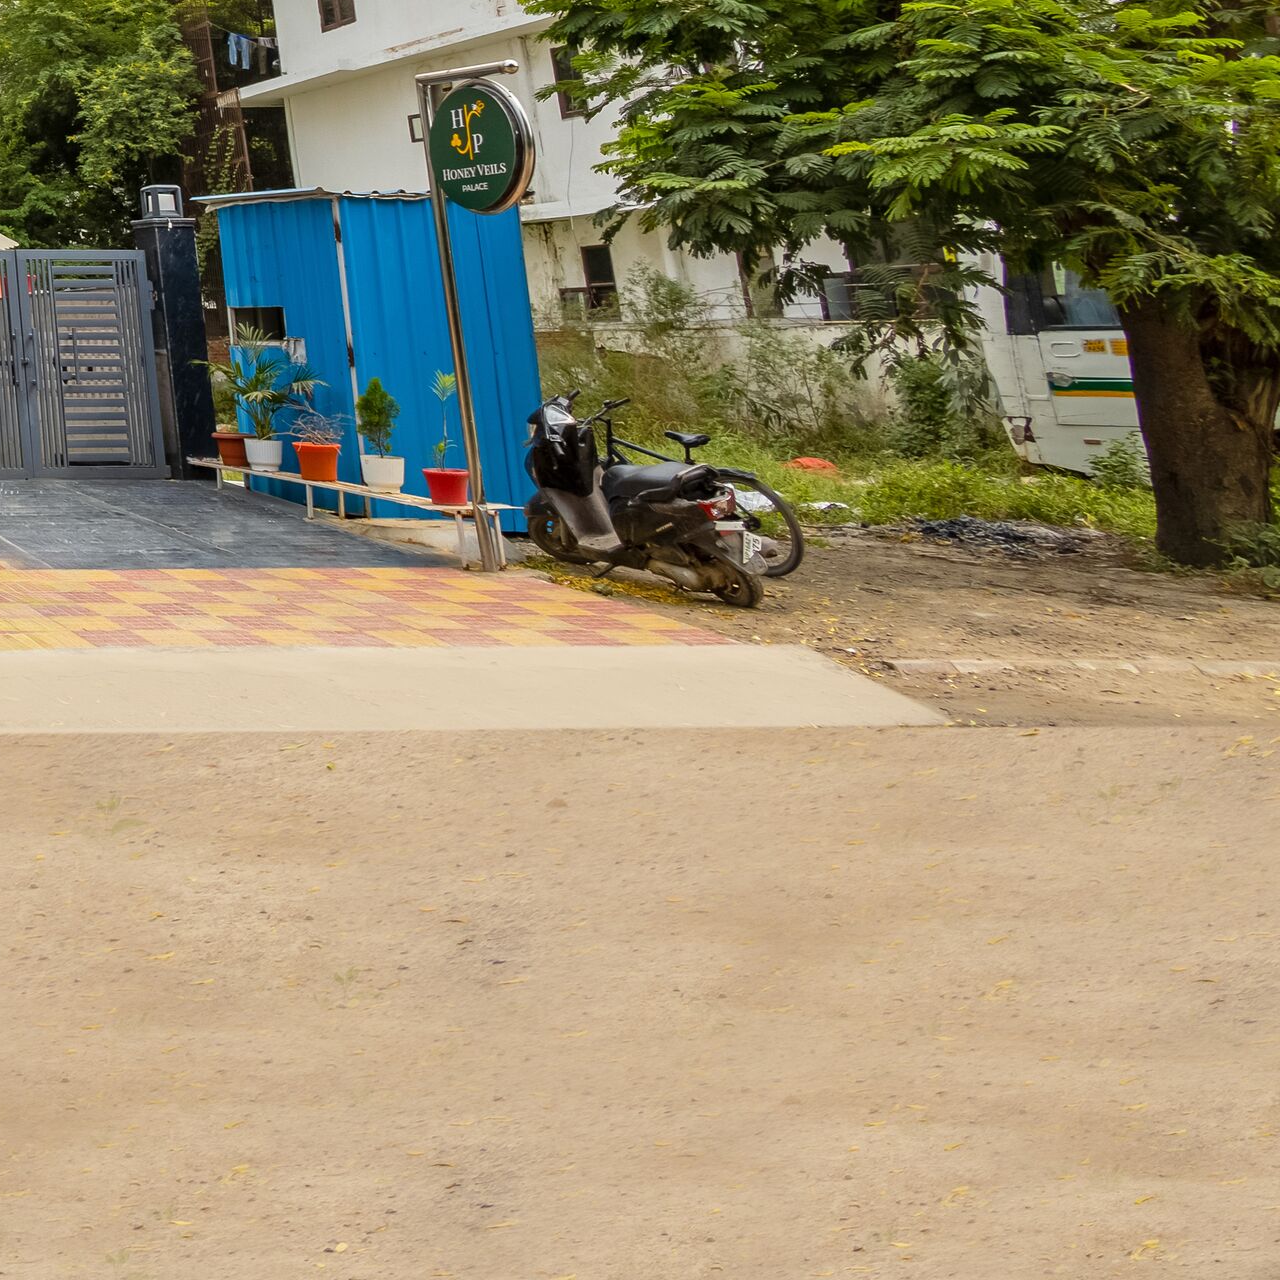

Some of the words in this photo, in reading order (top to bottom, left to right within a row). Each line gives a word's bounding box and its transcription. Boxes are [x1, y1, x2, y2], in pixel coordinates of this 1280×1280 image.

[442, 166, 476, 181] HONEY
[475, 162, 507, 177] VEILS
[461, 182, 489, 192] PALACE
